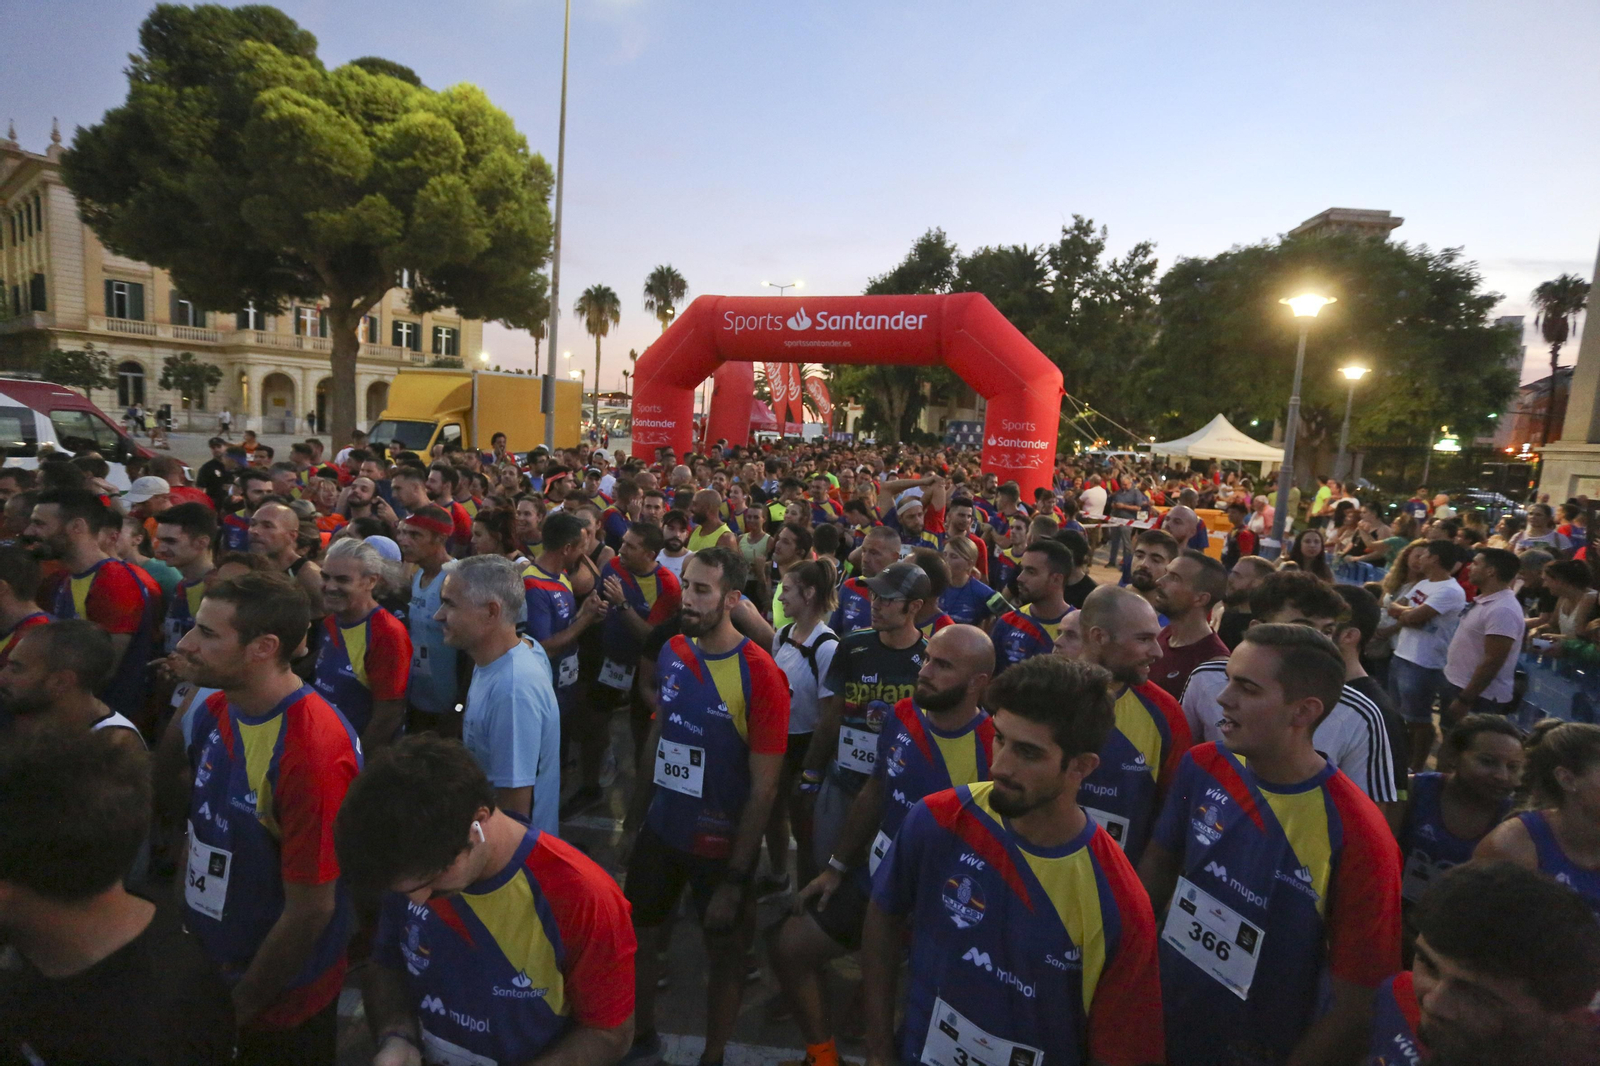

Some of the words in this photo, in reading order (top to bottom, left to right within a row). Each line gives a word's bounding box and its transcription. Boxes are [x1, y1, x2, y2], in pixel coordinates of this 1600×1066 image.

[723, 311, 783, 334] Sports
[815, 311, 928, 330] Santander
[784, 339, 852, 348] sportssantander.es
[637, 403, 662, 414] Sports
[635, 417, 676, 428] Santander
[1002, 419, 1036, 432] Sports
[997, 437, 1049, 450] Santander
[861, 673, 878, 683] trail
[845, 680, 915, 705] apitan
[851, 748, 875, 763] 426
[664, 763, 690, 780] 803
[1084, 782, 1118, 797] mupol
[1205, 787, 1229, 805] vive
[958, 852, 986, 871] vive
[1229, 877, 1268, 910] mupol
[1188, 921, 1231, 962] 366
[492, 985, 549, 998] Santander
[450, 1010, 491, 1033] mupol
